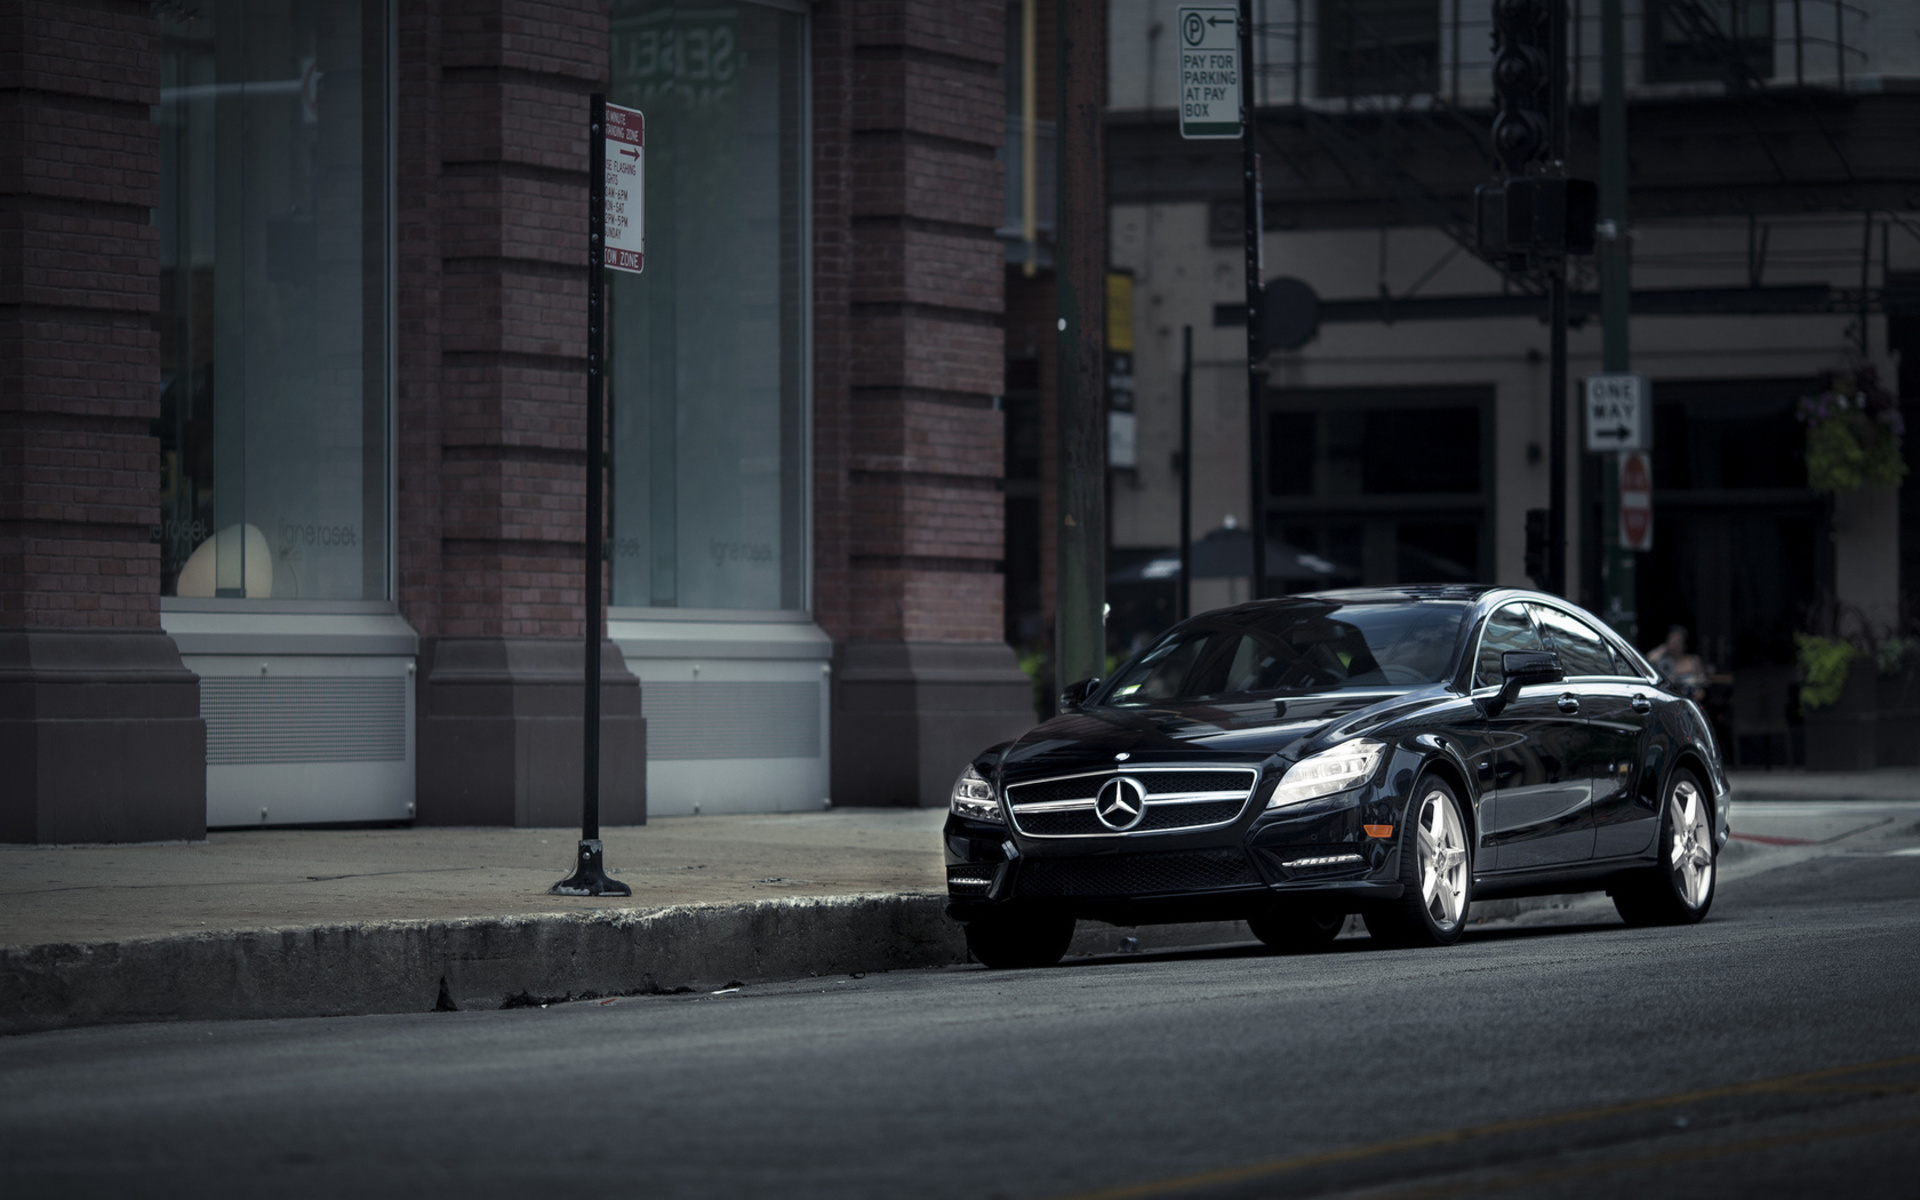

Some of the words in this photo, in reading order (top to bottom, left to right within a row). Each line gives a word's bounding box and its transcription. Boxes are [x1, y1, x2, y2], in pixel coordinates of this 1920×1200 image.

[1184, 55, 1206, 69] PAY
[1210, 55, 1233, 69] FOR
[1184, 71, 1236, 85] PARKING
[1186, 87, 1200, 101] AT
[1204, 87, 1226, 101] PAY
[1185, 103, 1209, 117] BOX
[625, 129, 639, 142] ZONE
[614, 161, 636, 175] FLASHING
[620, 251, 639, 268] ZONE
[1593, 382, 1632, 399] ONE
[1593, 402, 1634, 420] WAY
